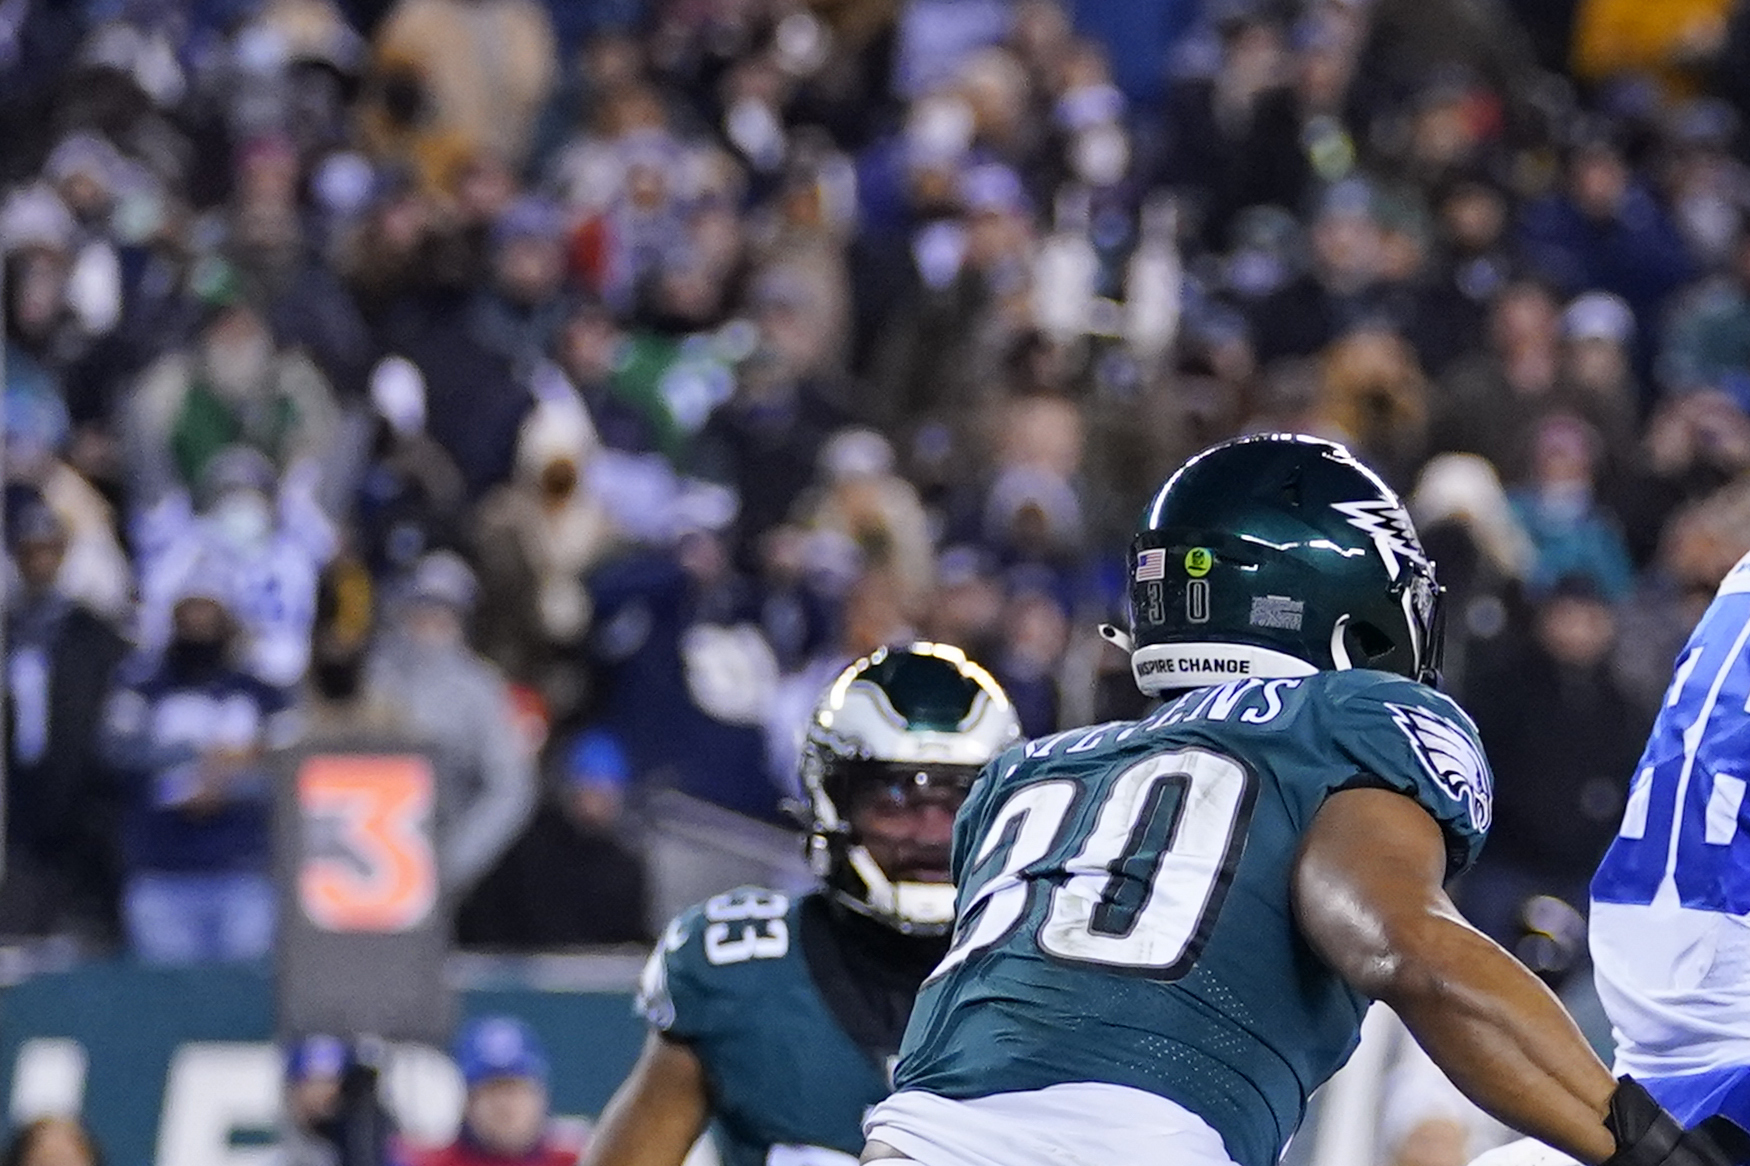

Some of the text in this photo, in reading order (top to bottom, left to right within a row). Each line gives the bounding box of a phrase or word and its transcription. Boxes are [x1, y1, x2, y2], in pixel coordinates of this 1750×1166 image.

[1178, 658, 1250, 674] CHANGE
[298, 754, 438, 933] 3
[919, 745, 1261, 984] 30
[704, 893, 789, 966] 33
